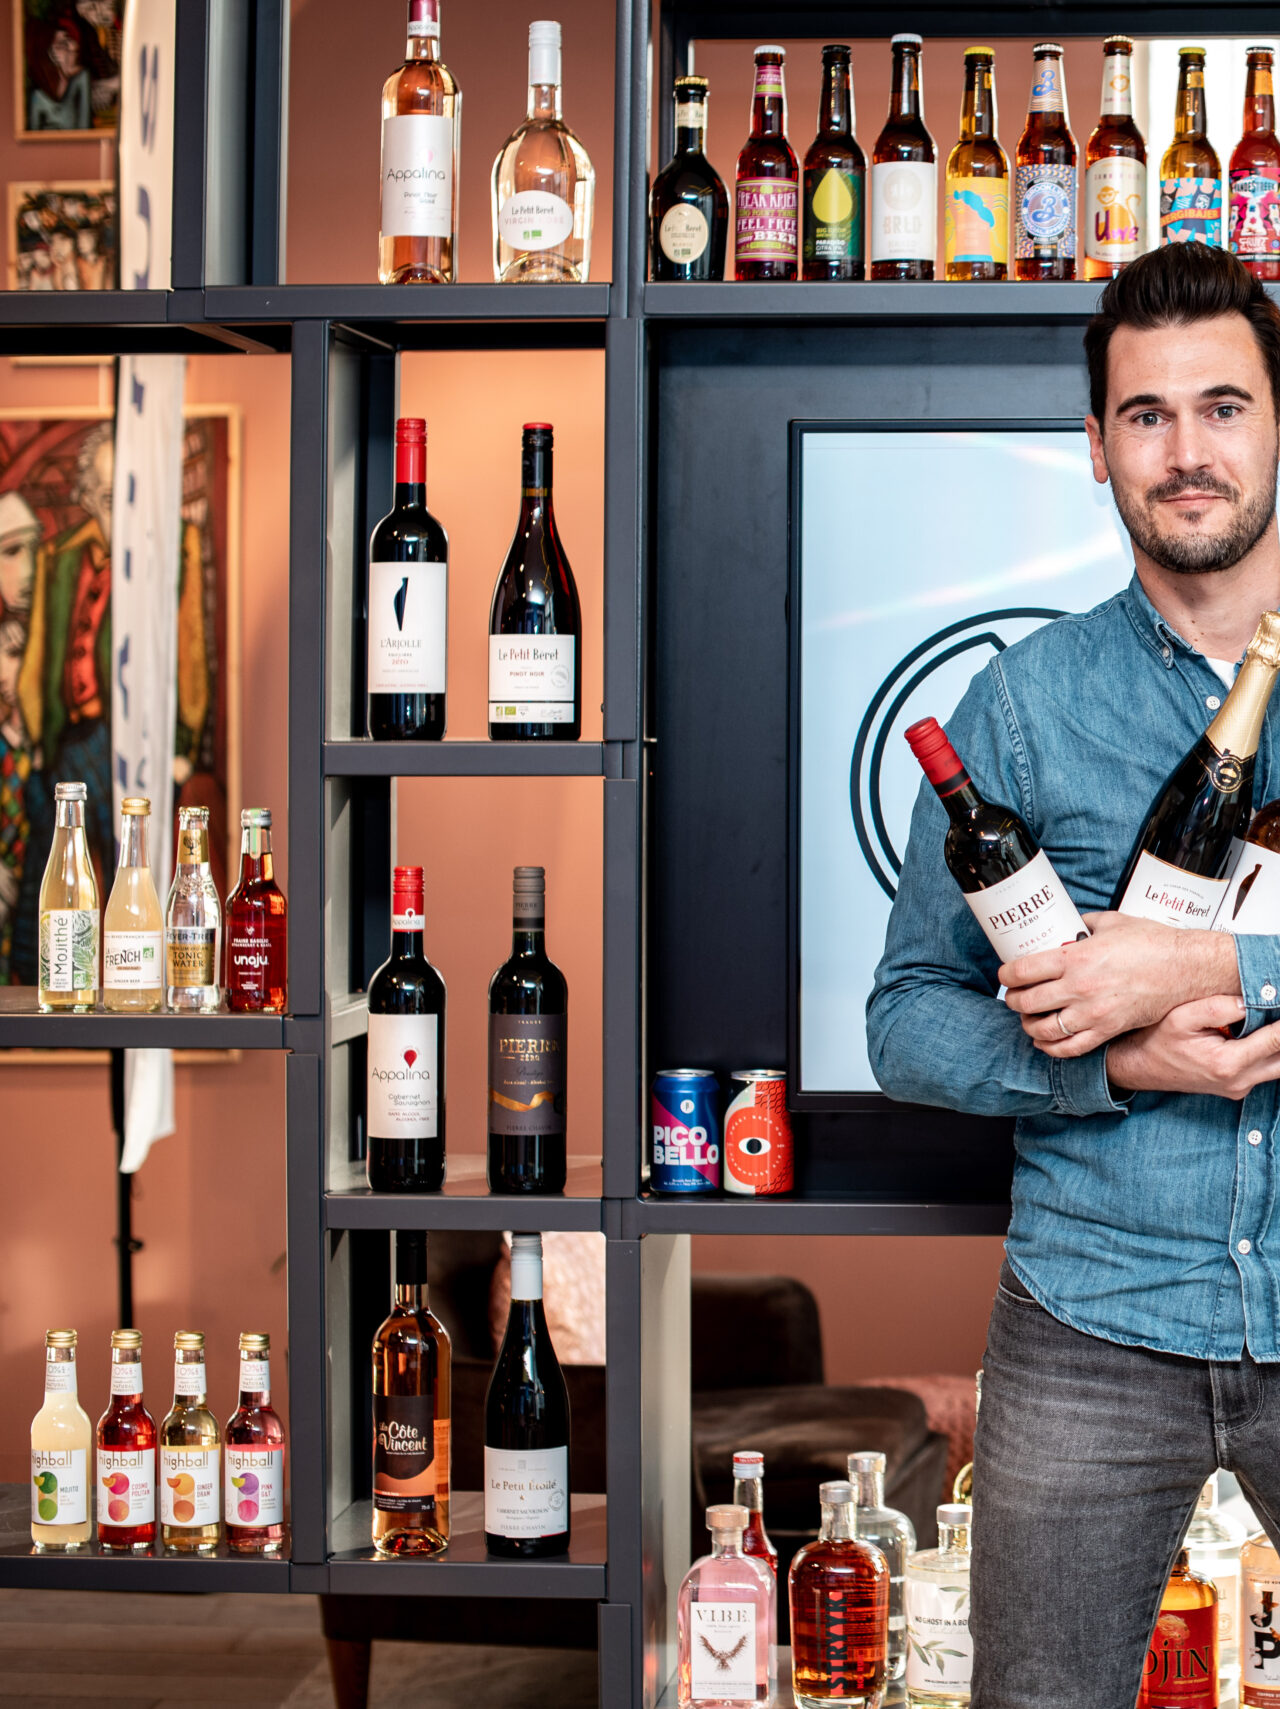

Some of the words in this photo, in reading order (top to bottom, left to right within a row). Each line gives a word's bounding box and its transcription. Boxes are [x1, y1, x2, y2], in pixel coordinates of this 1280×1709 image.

[387, 167, 446, 182] Appalina
[768, 218, 797, 233] FREE
[753, 230, 797, 246] BEER
[498, 648, 508, 660] Le
[509, 648, 530, 660] Petit
[988, 884, 1054, 930] PIERRE
[1144, 884, 1159, 902] Le
[1159, 891, 1185, 912] Petit
[1185, 900, 1212, 918] Béret
[1018, 914, 1040, 930] ZÉRO
[53, 915, 68, 975] Mojithé
[1018, 925, 1054, 950] MERLOT
[105, 949, 141, 968] FRENCH
[172, 951, 203, 960] TONIC
[172, 959, 204, 968] WATER
[233, 951, 268, 969] unaju
[371, 1066, 430, 1083] Appalina
[388, 1093, 421, 1101] Cabernet
[653, 1125, 708, 1146] PICO
[653, 1143, 720, 1166] BELLO
[388, 1420, 419, 1439] Côte
[383, 1433, 428, 1452] Vincent
[196, 1482, 213, 1490] GINGER
[491, 1479, 501, 1489] Le
[131, 1489, 150, 1497] POLITAN
[922, 1616, 943, 1625] GHOST
[825, 1596, 848, 1690] STRYYK
